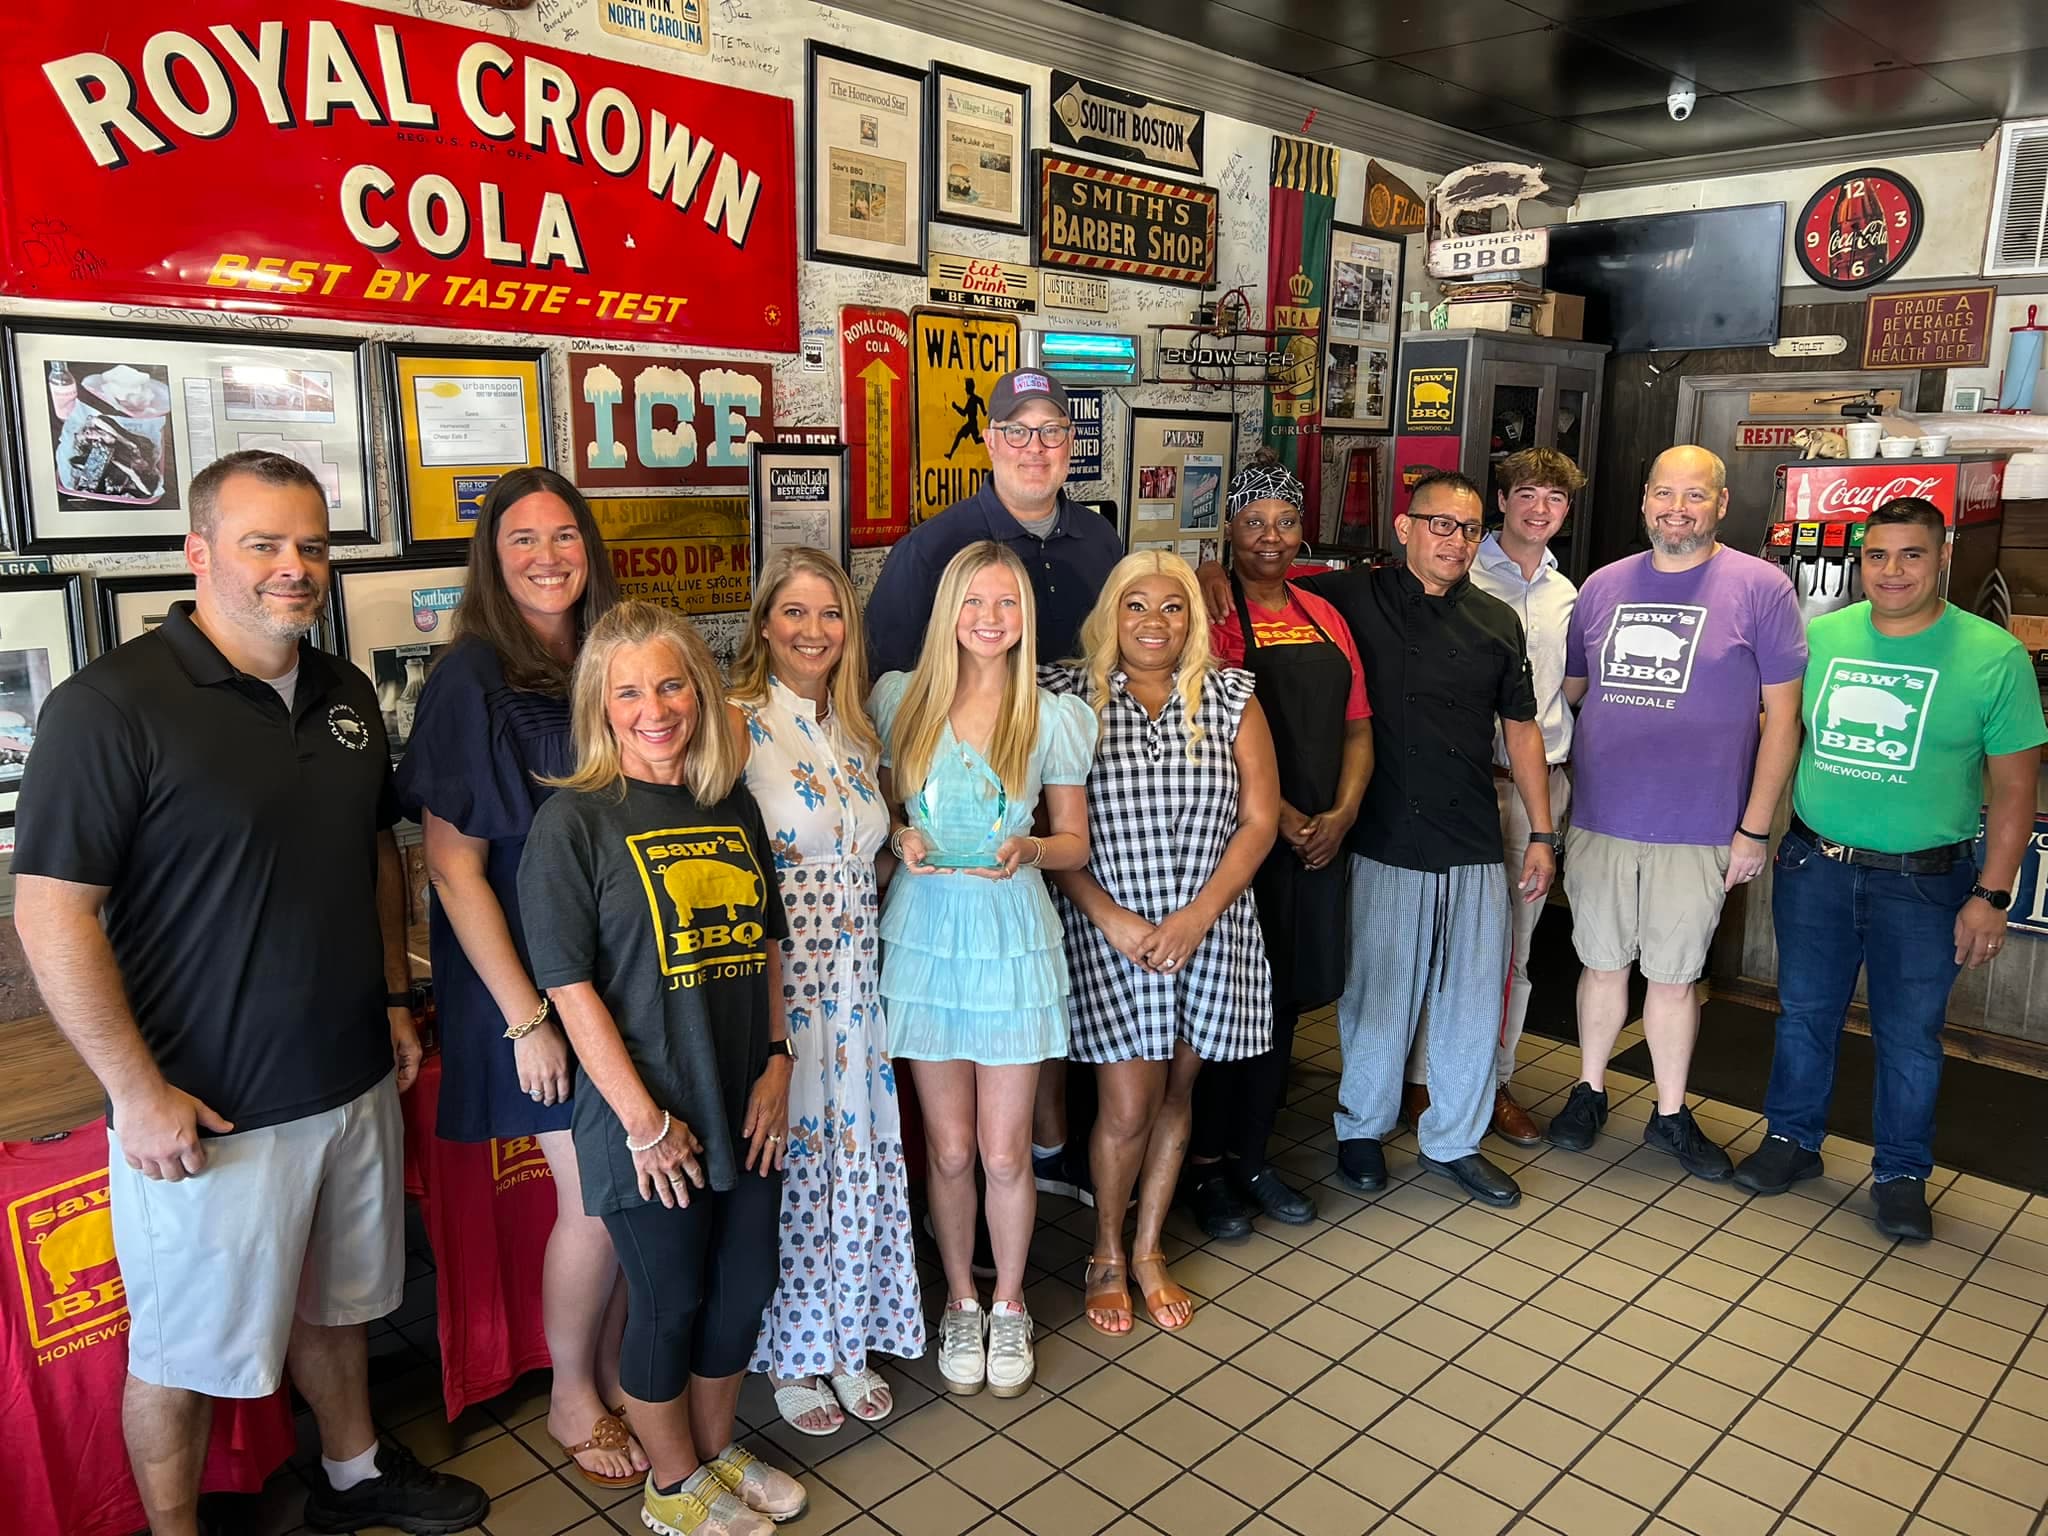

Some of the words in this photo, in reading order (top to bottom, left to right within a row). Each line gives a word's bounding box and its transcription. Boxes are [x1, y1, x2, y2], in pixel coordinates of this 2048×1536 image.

[608, 3, 646, 31] NORTH
[650, 13, 703, 45] CAROLINA
[831, 81, 848, 97] The
[848, 86, 891, 107] Homewood
[891, 97, 906, 111] Star
[956, 97, 981, 113] Village
[981, 103, 1005, 119] Living
[42, 20, 438, 171] ROYAL
[457, 42, 763, 250] CROWN
[1080, 100, 1126, 138] SOUTH
[1132, 116, 1185, 153] BOSTON
[1843, 180, 1866, 200] 12
[1071, 181, 1191, 226] SMITH'S
[340, 164, 591, 274] COLA
[1894, 210, 1908, 228] 3
[1052, 203, 1137, 257] BARBER
[1806, 231, 1820, 248] 9
[1828, 219, 1888, 258] Coca-Cola
[1442, 233, 1536, 251] SOUTHERN
[968, 259, 1002, 278] Eat
[1453, 246, 1522, 271] BBQ
[1851, 260, 1865, 277] 6
[206, 253, 354, 295] BEST
[363, 269, 431, 302] BY
[962, 274, 1008, 294] Drink
[1047, 279, 1075, 295] JUSTICE
[1087, 283, 1107, 300] PEACE
[1060, 296, 1096, 306] BALTIMORE
[1894, 298, 1947, 316] GRADE
[1954, 295, 1971, 311] A
[1883, 311, 1975, 332] BEVERAGES
[843, 318, 876, 345] ROYAL
[876, 319, 909, 348] CROWN
[1882, 331, 1913, 347] ALA
[1922, 328, 1969, 345] STATE
[865, 339, 890, 353] COLA
[925, 328, 1009, 373] WATCH
[1871, 347, 1926, 363] HEALTH
[1935, 343, 1976, 360] DEPT
[1166, 348, 1296, 367] BUDWEISER
[462, 382, 519, 391] urbanspoon
[1413, 372, 1453, 382] saw's
[583, 363, 764, 469] ICE
[1410, 408, 1451, 420] BBQ
[1077, 426, 1100, 436] WALLS
[771, 468, 807, 488] Cooking
[806, 468, 828, 488] Light
[925, 467, 992, 507] CHILD
[777, 486, 796, 496] BEST
[796, 486, 825, 496] RECIPES
[652, 580, 673, 594] ALL
[677, 579, 703, 592] LIVE
[706, 576, 743, 590] STOCK
[686, 593, 706, 605] AND
[1620, 611, 1697, 625] saw's
[1606, 662, 1681, 685] BBQ
[1834, 669, 1925, 690] saw's
[1601, 692, 1676, 710] AVONDALE
[1819, 728, 1908, 761] BBQ
[1814, 758, 1885, 783] HOMEWOOD,
[1887, 774, 1908, 784] AL
[645, 835, 746, 861] saw's
[669, 921, 764, 956] BBQ
[712, 961, 767, 979] JOINT
